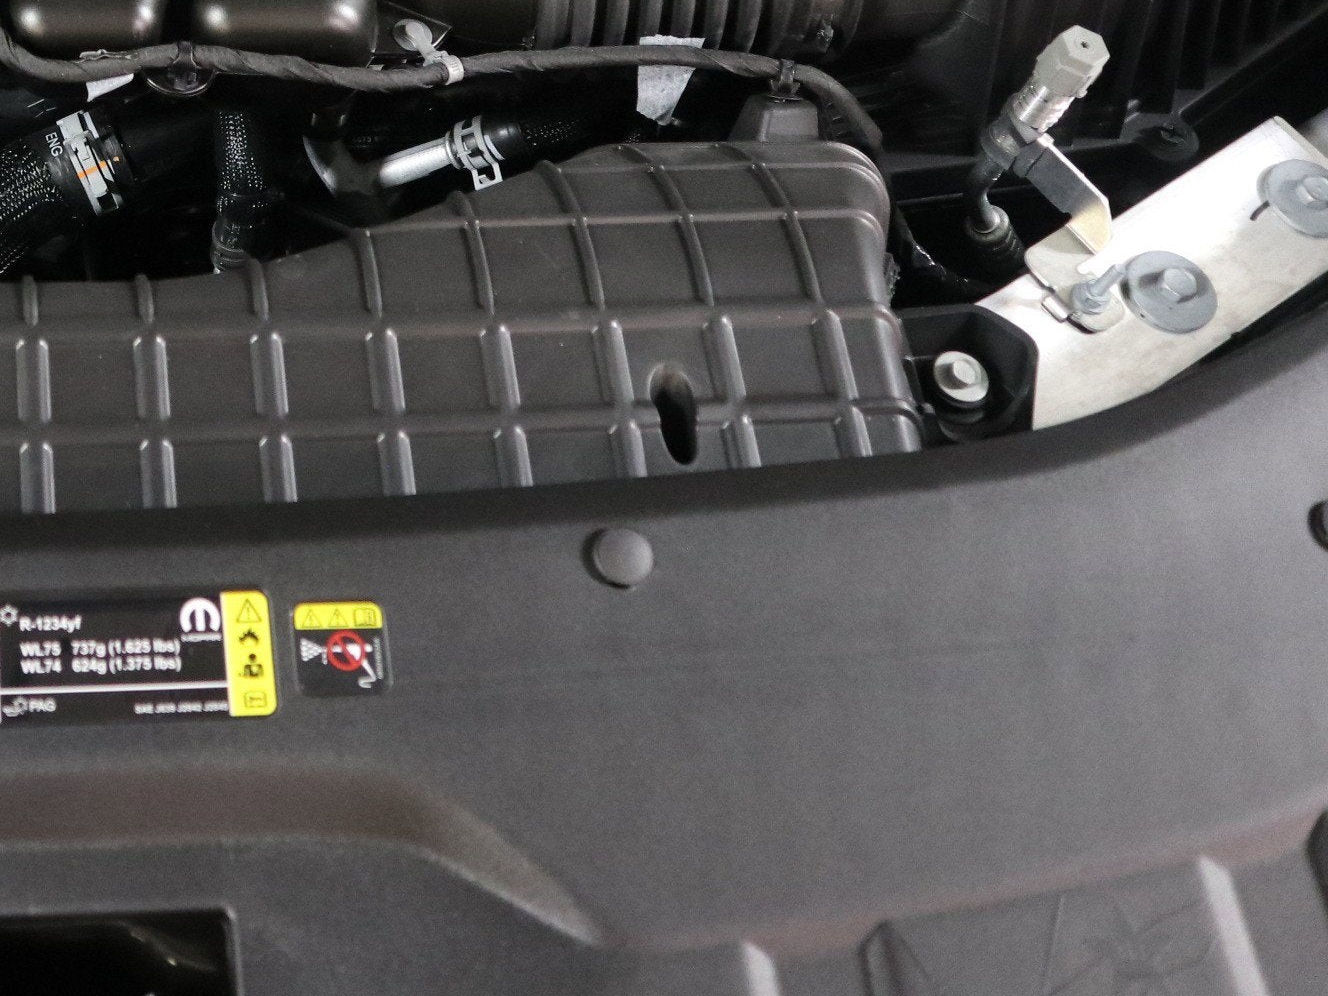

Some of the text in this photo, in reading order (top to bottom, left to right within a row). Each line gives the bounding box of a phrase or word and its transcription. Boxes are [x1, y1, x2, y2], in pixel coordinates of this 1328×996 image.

[45, 132, 64, 158] ENG
[19, 614, 82, 633] R-1234yf
[19, 641, 61, 657] WL75
[71, 639, 106, 657] 737g
[108, 638, 151, 657] (1.625
[153, 637, 180, 656] lbs)
[20, 654, 182, 675] WL74 624g (1.375 lbs)
